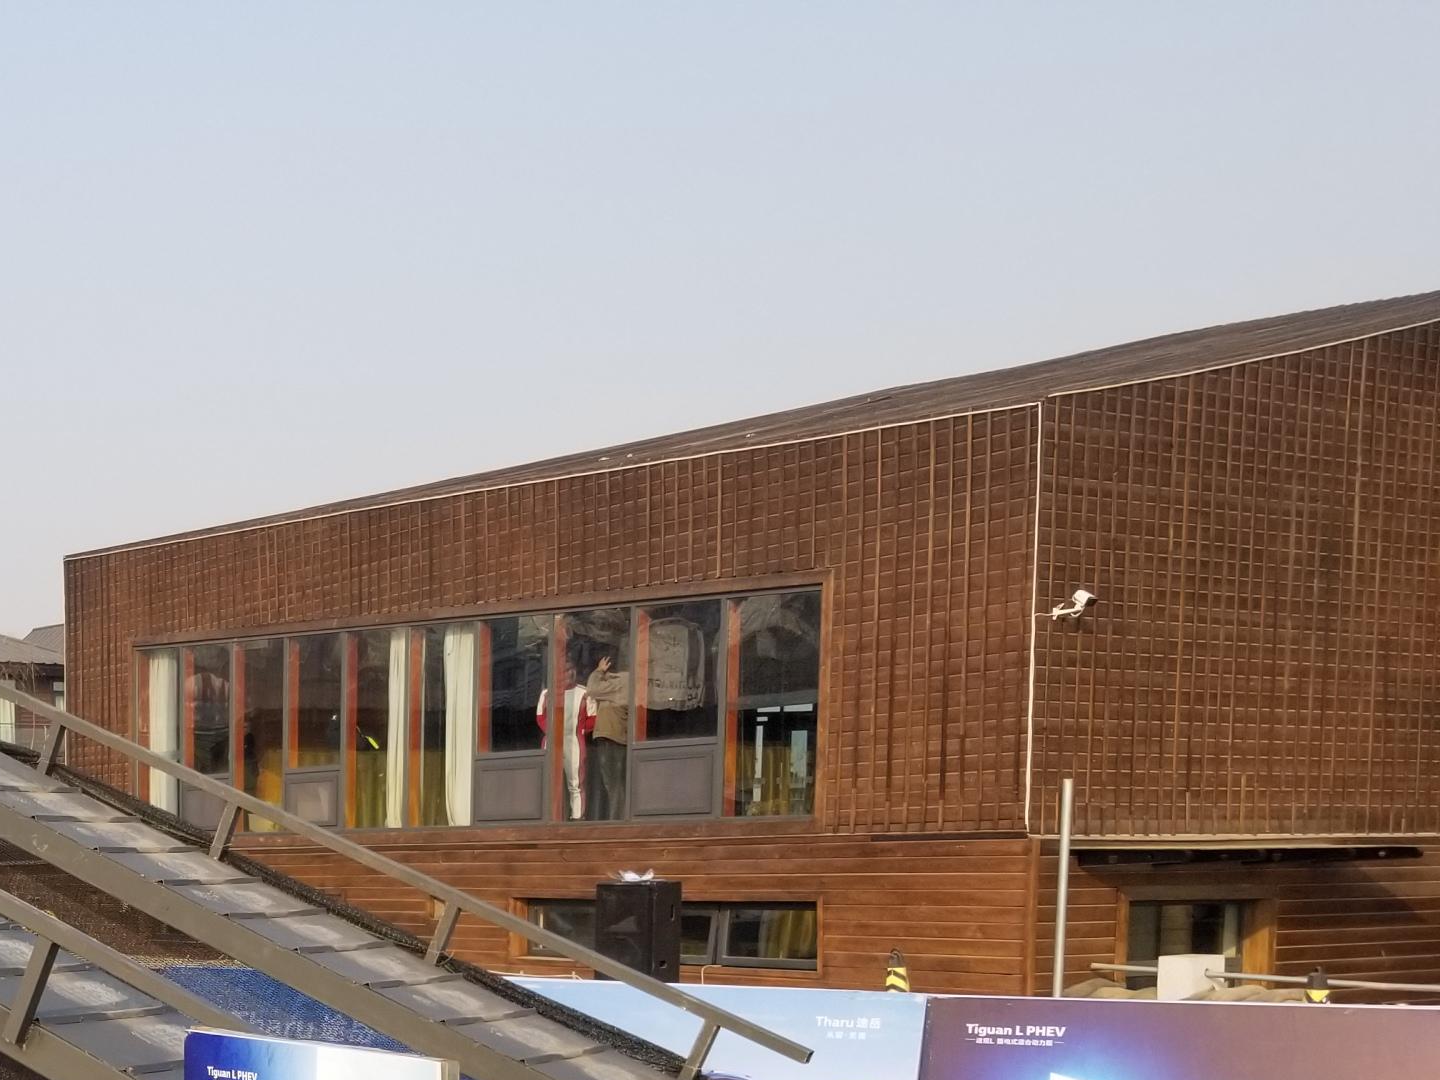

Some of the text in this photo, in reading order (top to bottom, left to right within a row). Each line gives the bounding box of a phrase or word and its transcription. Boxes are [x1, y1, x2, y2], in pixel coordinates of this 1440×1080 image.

[966, 1023, 1067, 1037] Tiguan L PHEV
[206, 1065, 231, 1079] Tiguan
[232, 1070, 237, 1080] L
